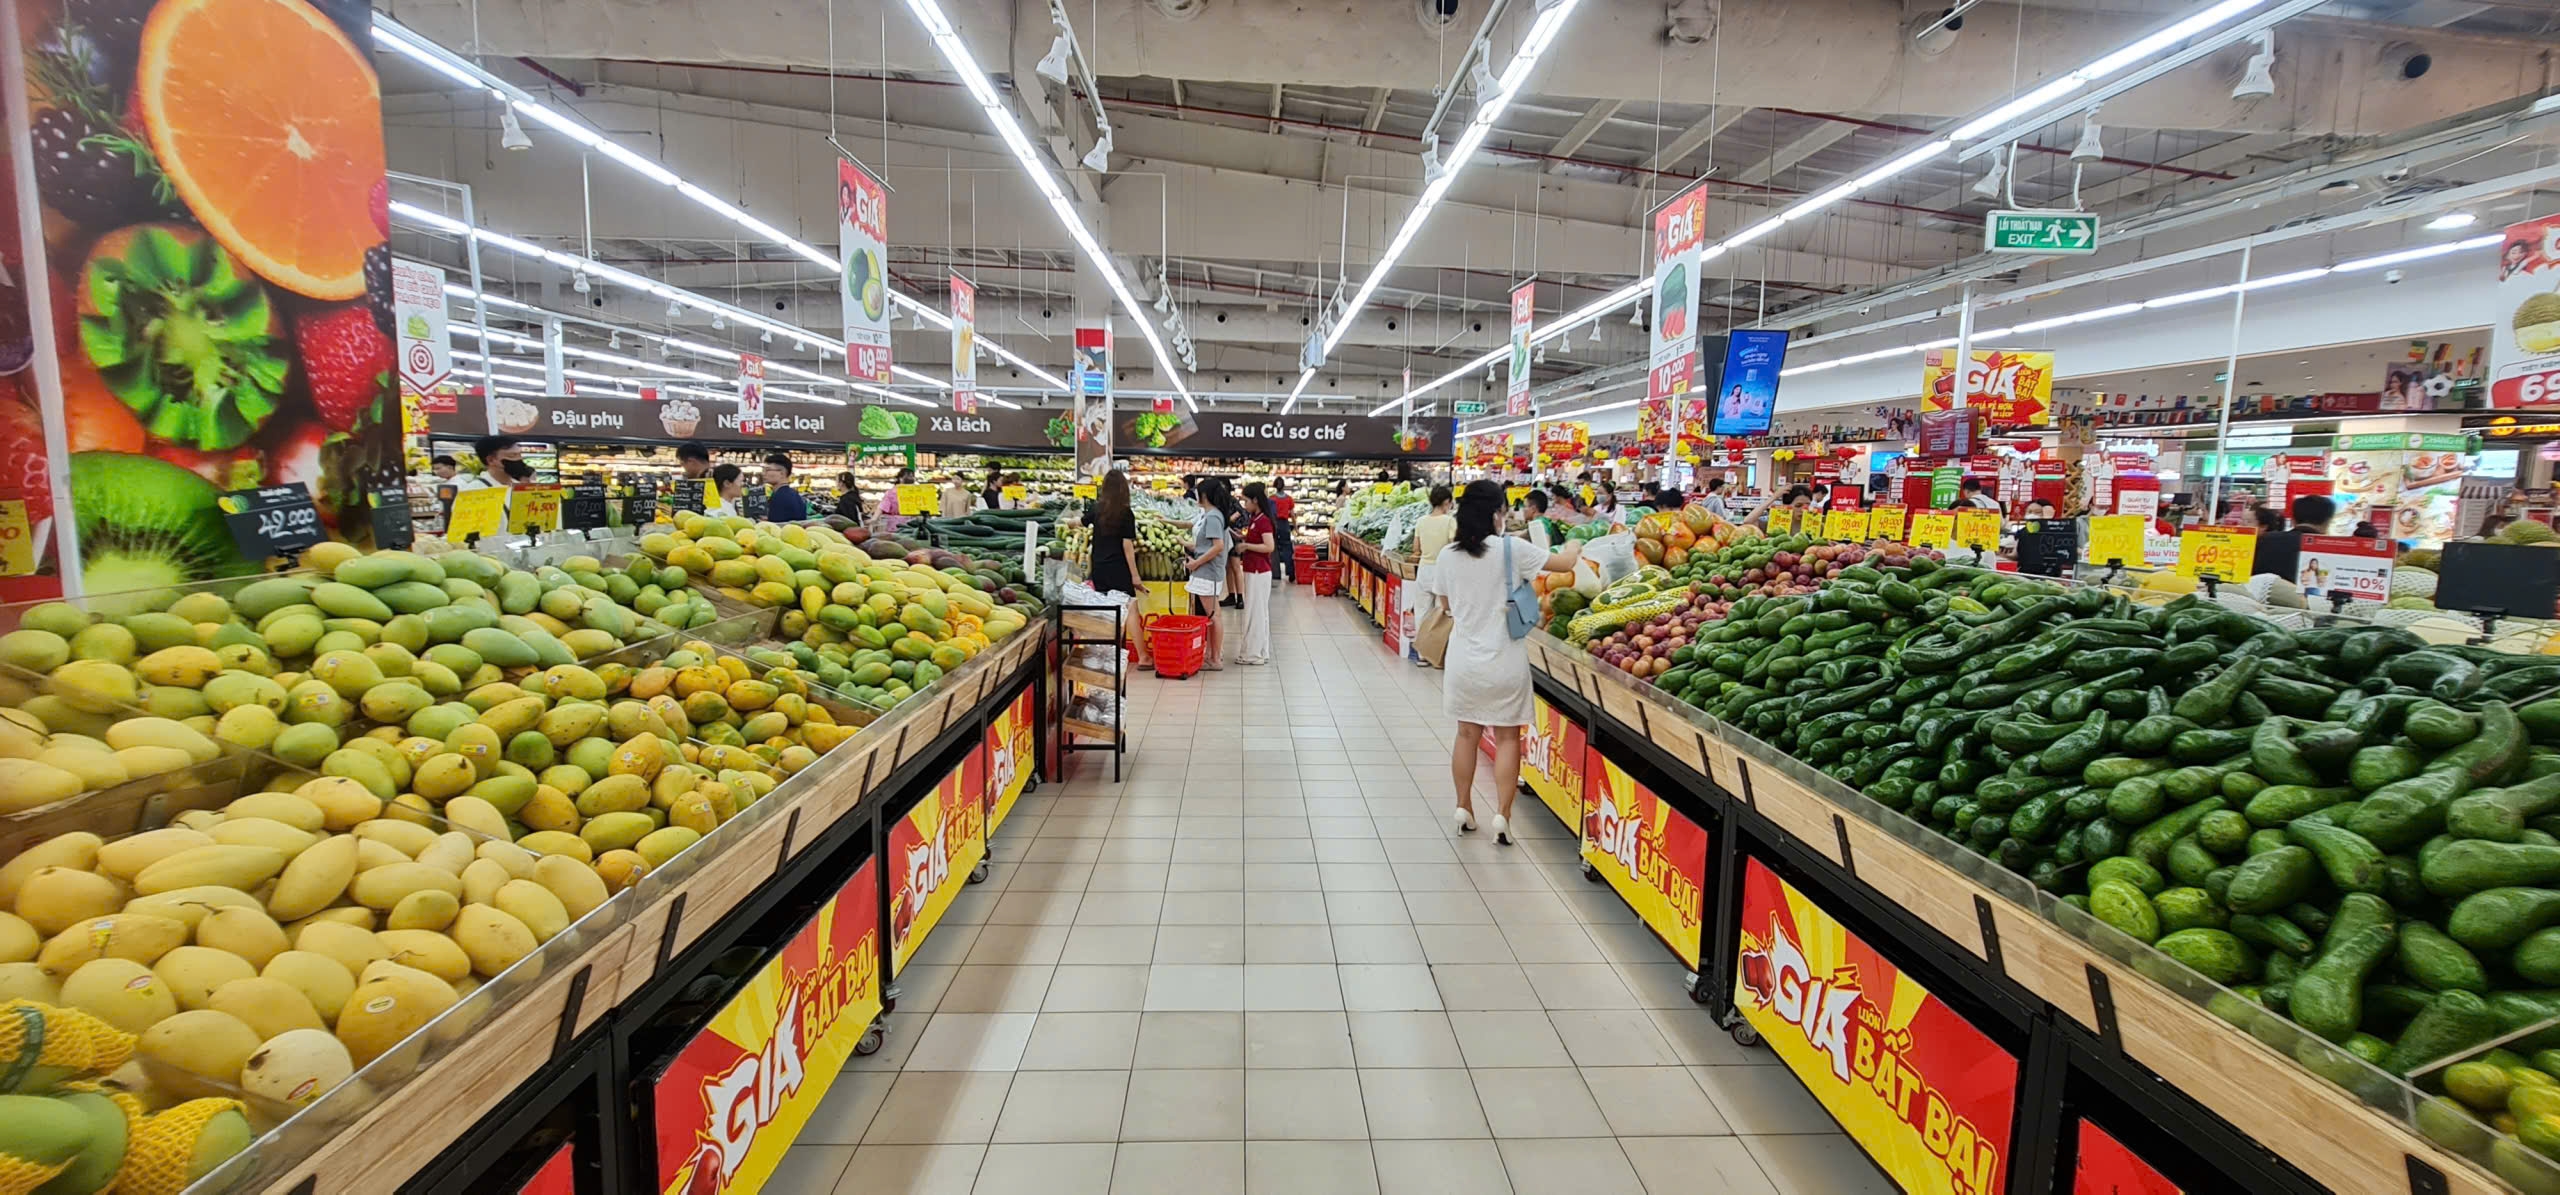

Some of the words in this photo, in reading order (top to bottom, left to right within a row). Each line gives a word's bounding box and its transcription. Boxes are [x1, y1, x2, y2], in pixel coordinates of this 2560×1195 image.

[1667, 198, 1697, 249] GIÁ
[2008, 233, 2035, 245] EXIT
[1964, 357, 2024, 401] GIÁ
[551, 410, 587, 426] Đậu
[590, 411, 623, 430] phụ
[763, 414, 793, 430] các
[794, 415, 825, 433] loại
[930, 416, 953, 432] Xà
[956, 416, 990, 433] lách
[1222, 423, 1255, 438] Rau
[1260, 421, 1284, 439] Củ
[1289, 426, 1310, 440] sơ
[1314, 422, 1347, 440] chế
[2149, 538, 2167, 548] Trái
[2352, 576, 2385, 591] 10%
[1599, 781, 1643, 882] GIÁ
[906, 807, 949, 918] GIÁ
[1638, 835, 1669, 894] BẤT
[1671, 869, 1699, 928] BẠI
[802, 951, 842, 1050] BẤT
[846, 930, 874, 999] BẠI
[1772, 914, 1862, 1084] GIÁ
[1857, 1005, 1882, 1032] LUÔN
[701, 978, 805, 1188] GIÁ
[1853, 1028, 1920, 1122] BẤT
[1924, 1093, 1996, 1195] BẠI
